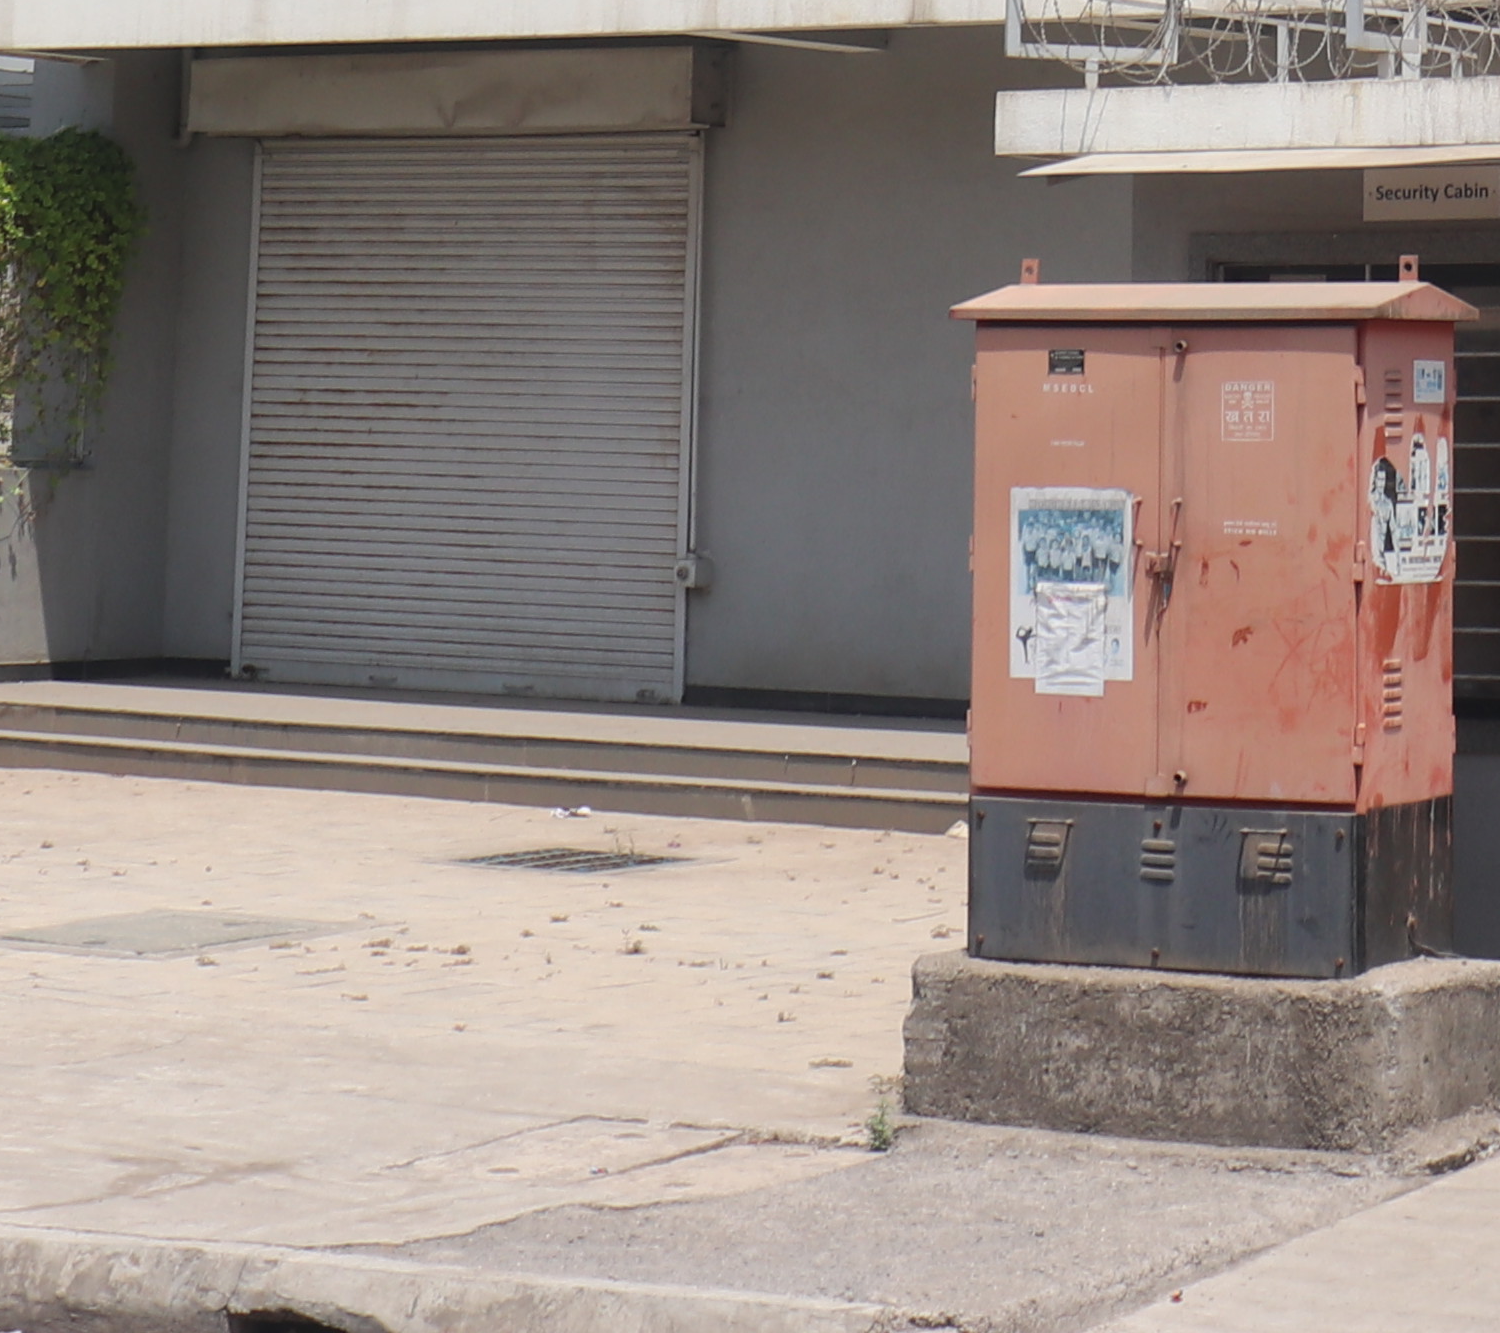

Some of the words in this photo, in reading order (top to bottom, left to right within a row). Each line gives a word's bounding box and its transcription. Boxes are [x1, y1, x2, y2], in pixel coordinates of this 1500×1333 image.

[1375, 183, 1440, 203] Security
[1444, 182, 1489, 200] Cabin
[1225, 383, 1271, 391] DANGER
